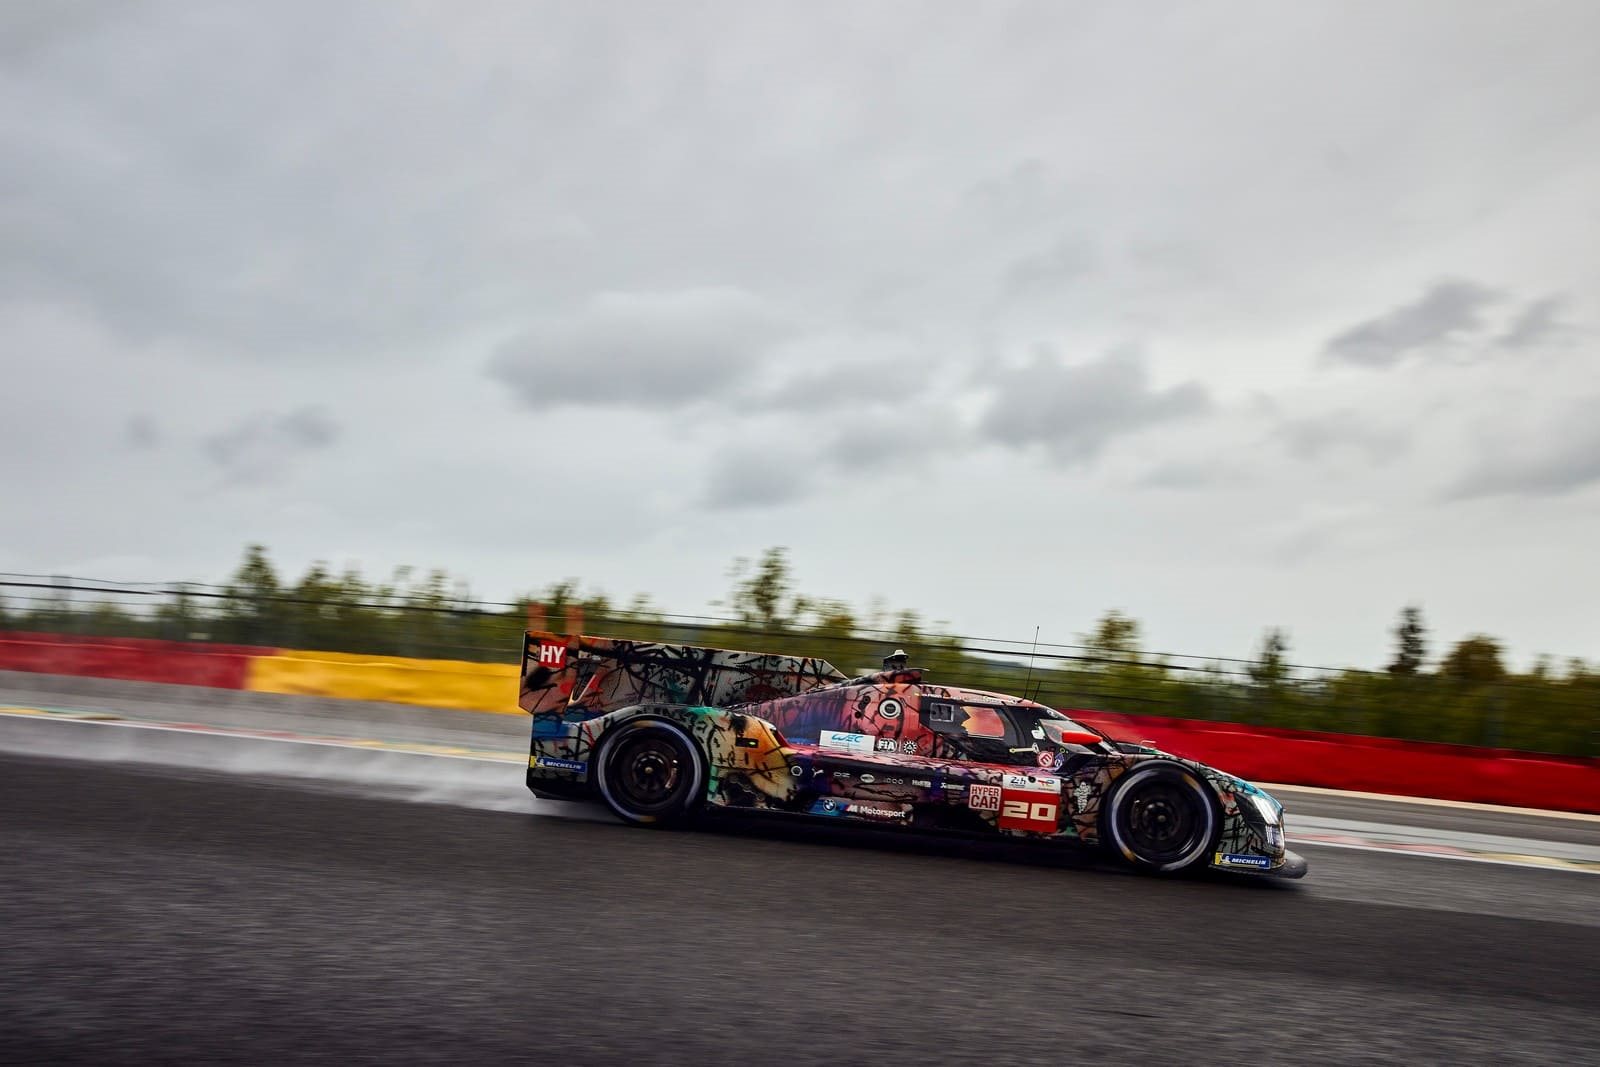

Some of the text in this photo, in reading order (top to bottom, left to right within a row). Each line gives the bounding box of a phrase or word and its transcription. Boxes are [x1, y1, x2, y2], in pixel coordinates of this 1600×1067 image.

[540, 645, 565, 663] HY
[831, 733, 863, 743] WEC
[878, 739, 896, 752] FIA
[546, 761, 581, 769] MICHELIN
[971, 786, 999, 796] HYPER
[970, 796, 999, 810] CAR
[860, 806, 905, 817] Motorsport
[1003, 800, 1057, 821] 20
